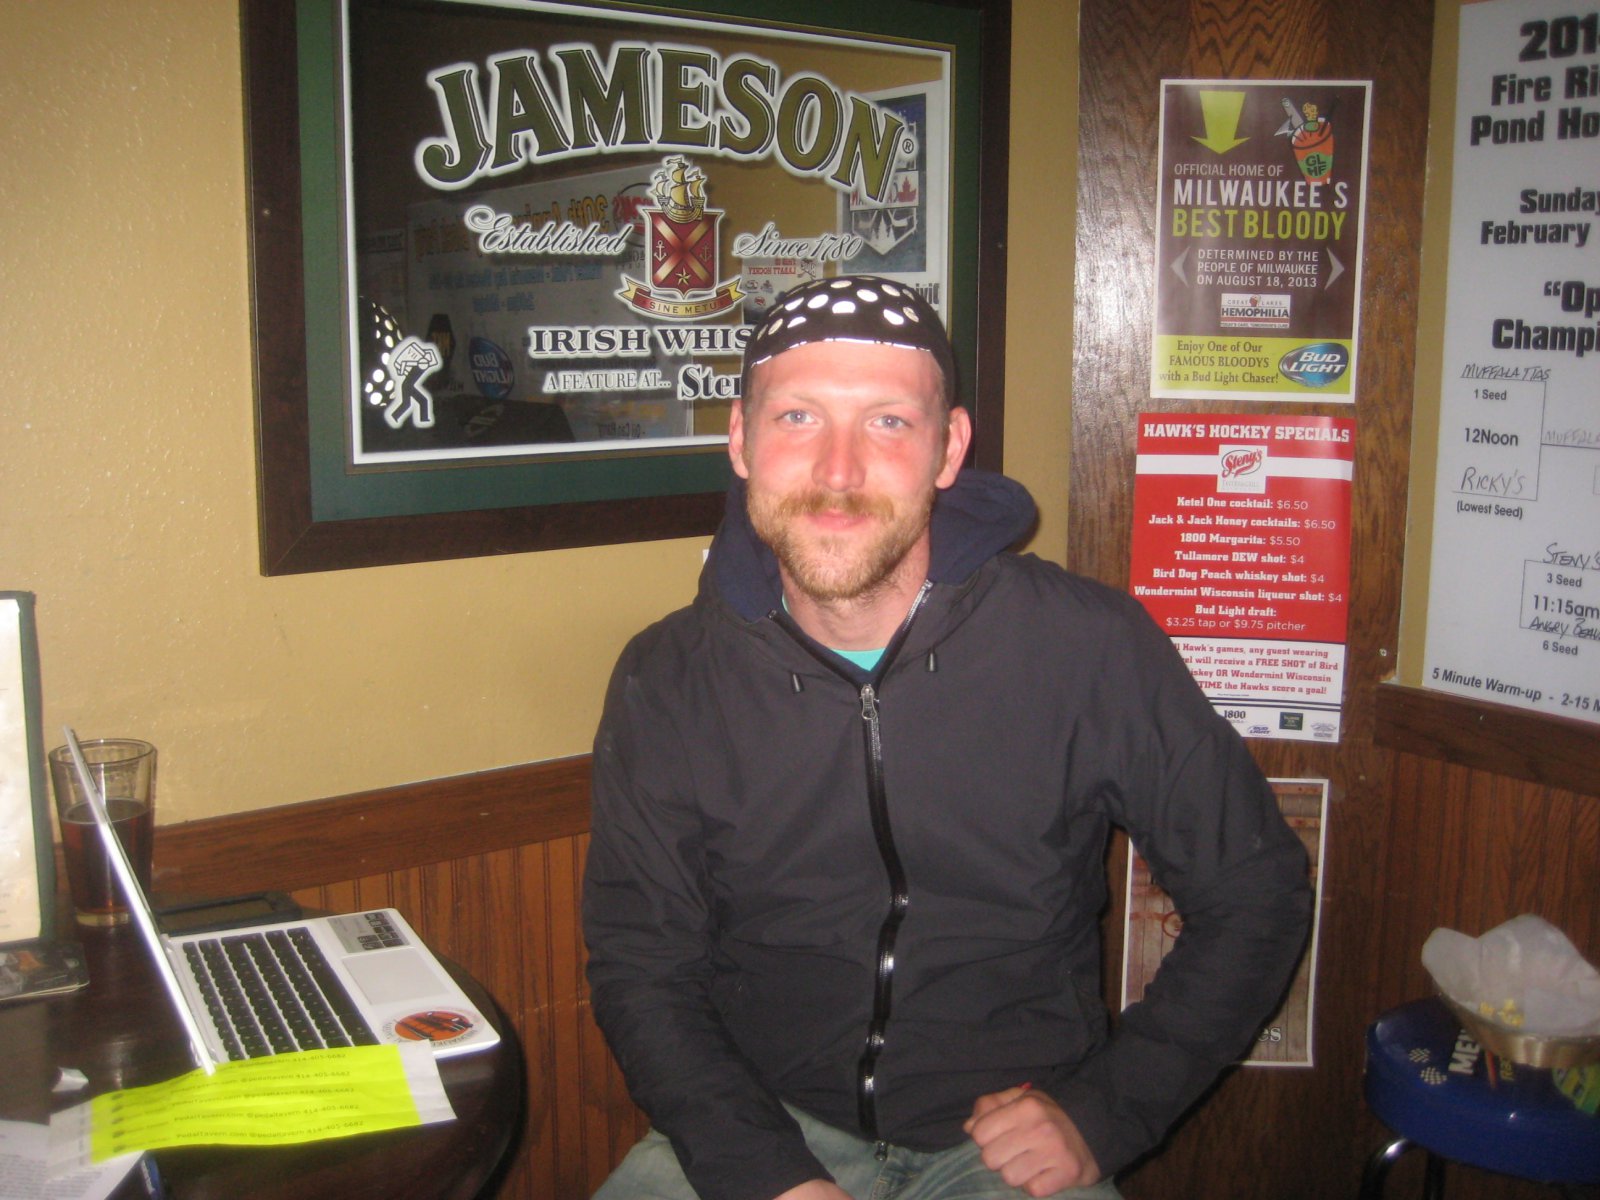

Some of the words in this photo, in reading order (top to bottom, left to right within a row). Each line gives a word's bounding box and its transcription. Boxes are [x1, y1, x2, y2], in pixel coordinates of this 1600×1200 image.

[1518, 12, 1600, 62] 201
[1490, 73, 1552, 106] Fire
[1564, 64, 1600, 99] Ri
[416, 43, 906, 203] JAMESON
[1470, 110, 1545, 147] Pond
[1174, 163, 1226, 176] OFFICIAL
[1228, 164, 1264, 177] HOME
[1267, 165, 1284, 177] OF
[1173, 178, 1348, 209] MILWAUKEE'S
[467, 206, 633, 255] Established
[1172, 209, 1239, 238] BEST
[1243, 210, 1346, 240] BLOODY
[1480, 220, 1591, 248] February
[734, 224, 809, 258] Since
[810, 233, 863, 261] 1780
[1198, 249, 1274, 262] DETERMINED
[1278, 250, 1294, 262] BY
[1296, 251, 1319, 262] THE
[1197, 261, 1237, 273] PEOPLE
[1239, 263, 1254, 273] OF
[1256, 263, 1318, 275] MILWAUKEE
[1196, 274, 1215, 285] ON
[1217, 275, 1262, 287] AUGUST
[1265, 276, 1284, 288] 18,
[1287, 276, 1317, 288] 2013
[649, 301, 679, 314] SINE
[684, 302, 717, 314] METU
[1221, 307, 1289, 317] HEMOPHILIA
[530, 327, 648, 354] IRISH
[1177, 340, 1204, 354] Enjoy
[1207, 340, 1227, 352] One
[1230, 341, 1241, 352] of
[1243, 341, 1263, 353] Our
[1169, 355, 1215, 367] FAMOUS
[1218, 356, 1270, 368] BLOODYS
[1299, 351, 1341, 363] BUD
[1289, 363, 1346, 374] LIGHT
[547, 373, 557, 391] A
[561, 372, 636, 390] FEATURE
[1159, 370, 1181, 381] with
[1183, 373, 1189, 381] a
[1192, 371, 1211, 382] Bud
[1214, 371, 1239, 385] Light
[1241, 372, 1279, 384] Chaser!
[1474, 389, 1479, 399] 1
[1482, 389, 1507, 401] Seed
[1143, 423, 1205, 438] HAWK'S
[1209, 424, 1271, 440] HOCKEY
[1274, 426, 1350, 443] SPECIALS
[1464, 427, 1519, 446] 12Noon
[1222, 449, 1263, 478] Steny's
[1460, 466, 1527, 496] RICKY'S
[1176, 496, 1204, 508] Ketel
[1207, 497, 1227, 508] One
[1229, 498, 1273, 509] cocktail:
[1276, 499, 1309, 511] $6.50
[1456, 500, 1492, 514] (Lowest
[1494, 504, 1523, 520] Seed)
[1148, 514, 1173, 525] Jack
[1176, 515, 1184, 525] &
[1187, 515, 1212, 525] Jack
[1215, 516, 1248, 528] Honey
[1250, 517, 1301, 528] cocktails:
[1304, 518, 1336, 530] $6.50
[1180, 532, 1206, 543] 1800
[1209, 533, 1266, 546] Margarita:
[1269, 535, 1301, 547] $5.50
[1174, 550, 1229, 562] Tullamore
[1231, 552, 1258, 563] DEW
[1260, 553, 1286, 564] shot:
[1290, 554, 1304, 565] $4
[1152, 568, 1175, 579] Bird
[1178, 568, 1198, 580] Dog
[1200, 569, 1232, 580] Peach
[1235, 570, 1279, 583] whiskey
[1281, 572, 1307, 583] shot:
[1310, 574, 1325, 584] $4
[1546, 572, 1553, 583] 3
[1555, 574, 1583, 588] Seed
[1134, 585, 1198, 597] Wondermint
[1200, 586, 1255, 598] Wisconsin
[1257, 588, 1297, 600] liqueur
[1298, 590, 1325, 601] shot:
[1328, 592, 1343, 603] $4
[1195, 604, 1216, 615] Bud
[1218, 605, 1246, 618] Light
[1247, 607, 1277, 617] draft:
[1533, 594, 1600, 620] 11:15am
[1165, 617, 1196, 627] $3.25
[1198, 618, 1217, 629] tap
[1219, 620, 1231, 628] or
[1233, 619, 1264, 630] $9.75
[1266, 620, 1306, 632] pitcher
[1182, 643, 1215, 652] Hawk's
[1215, 645, 1246, 654] games,
[1249, 646, 1264, 656] any
[1266, 646, 1290, 656] guest
[1292, 648, 1329, 659] wearing
[1542, 640, 1549, 651] 6
[1551, 641, 1579, 656] Seed
[1195, 656, 1211, 664] will
[1214, 657, 1246, 666] receive
[1255, 658, 1279, 667] FREE
[1281, 659, 1306, 668] SHOT
[1308, 660, 1317, 669] of
[1319, 660, 1339, 671] Bird
[1215, 668, 1229, 677] OR
[1230, 669, 1283, 680] Wondermint
[1286, 672, 1332, 683] Wisconsin
[1224, 681, 1238, 690] the
[1240, 682, 1270, 692] Hawks
[1272, 684, 1296, 693] score
[1431, 667, 1440, 680] 5
[1441, 668, 1482, 688] Minute
[1485, 677, 1542, 703] Warm-up
[1560, 692, 1590, 711] 2-15
[1223, 709, 1246, 719] 1800
